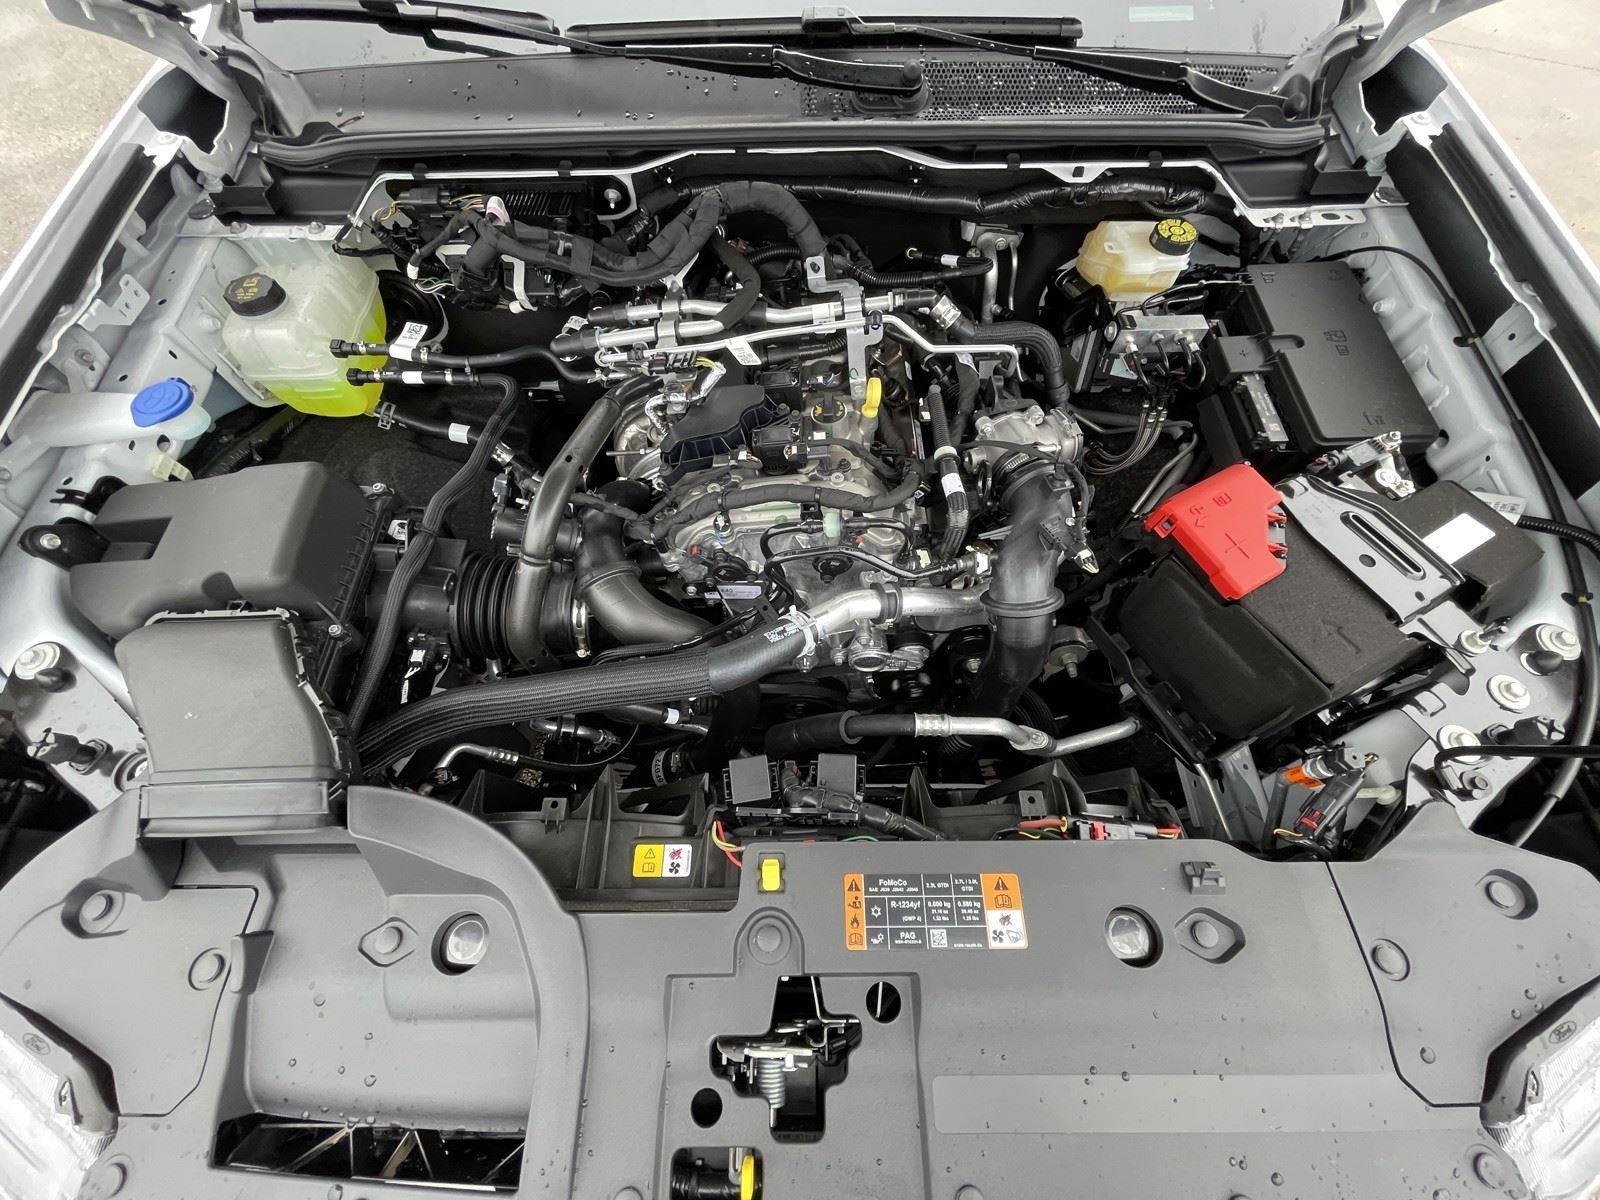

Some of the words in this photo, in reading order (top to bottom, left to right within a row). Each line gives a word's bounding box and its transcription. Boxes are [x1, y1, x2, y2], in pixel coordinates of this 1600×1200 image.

[890, 901, 921, 910] R-1234yf
[943, 901, 951, 909] kg
[973, 901, 981, 909] kg
